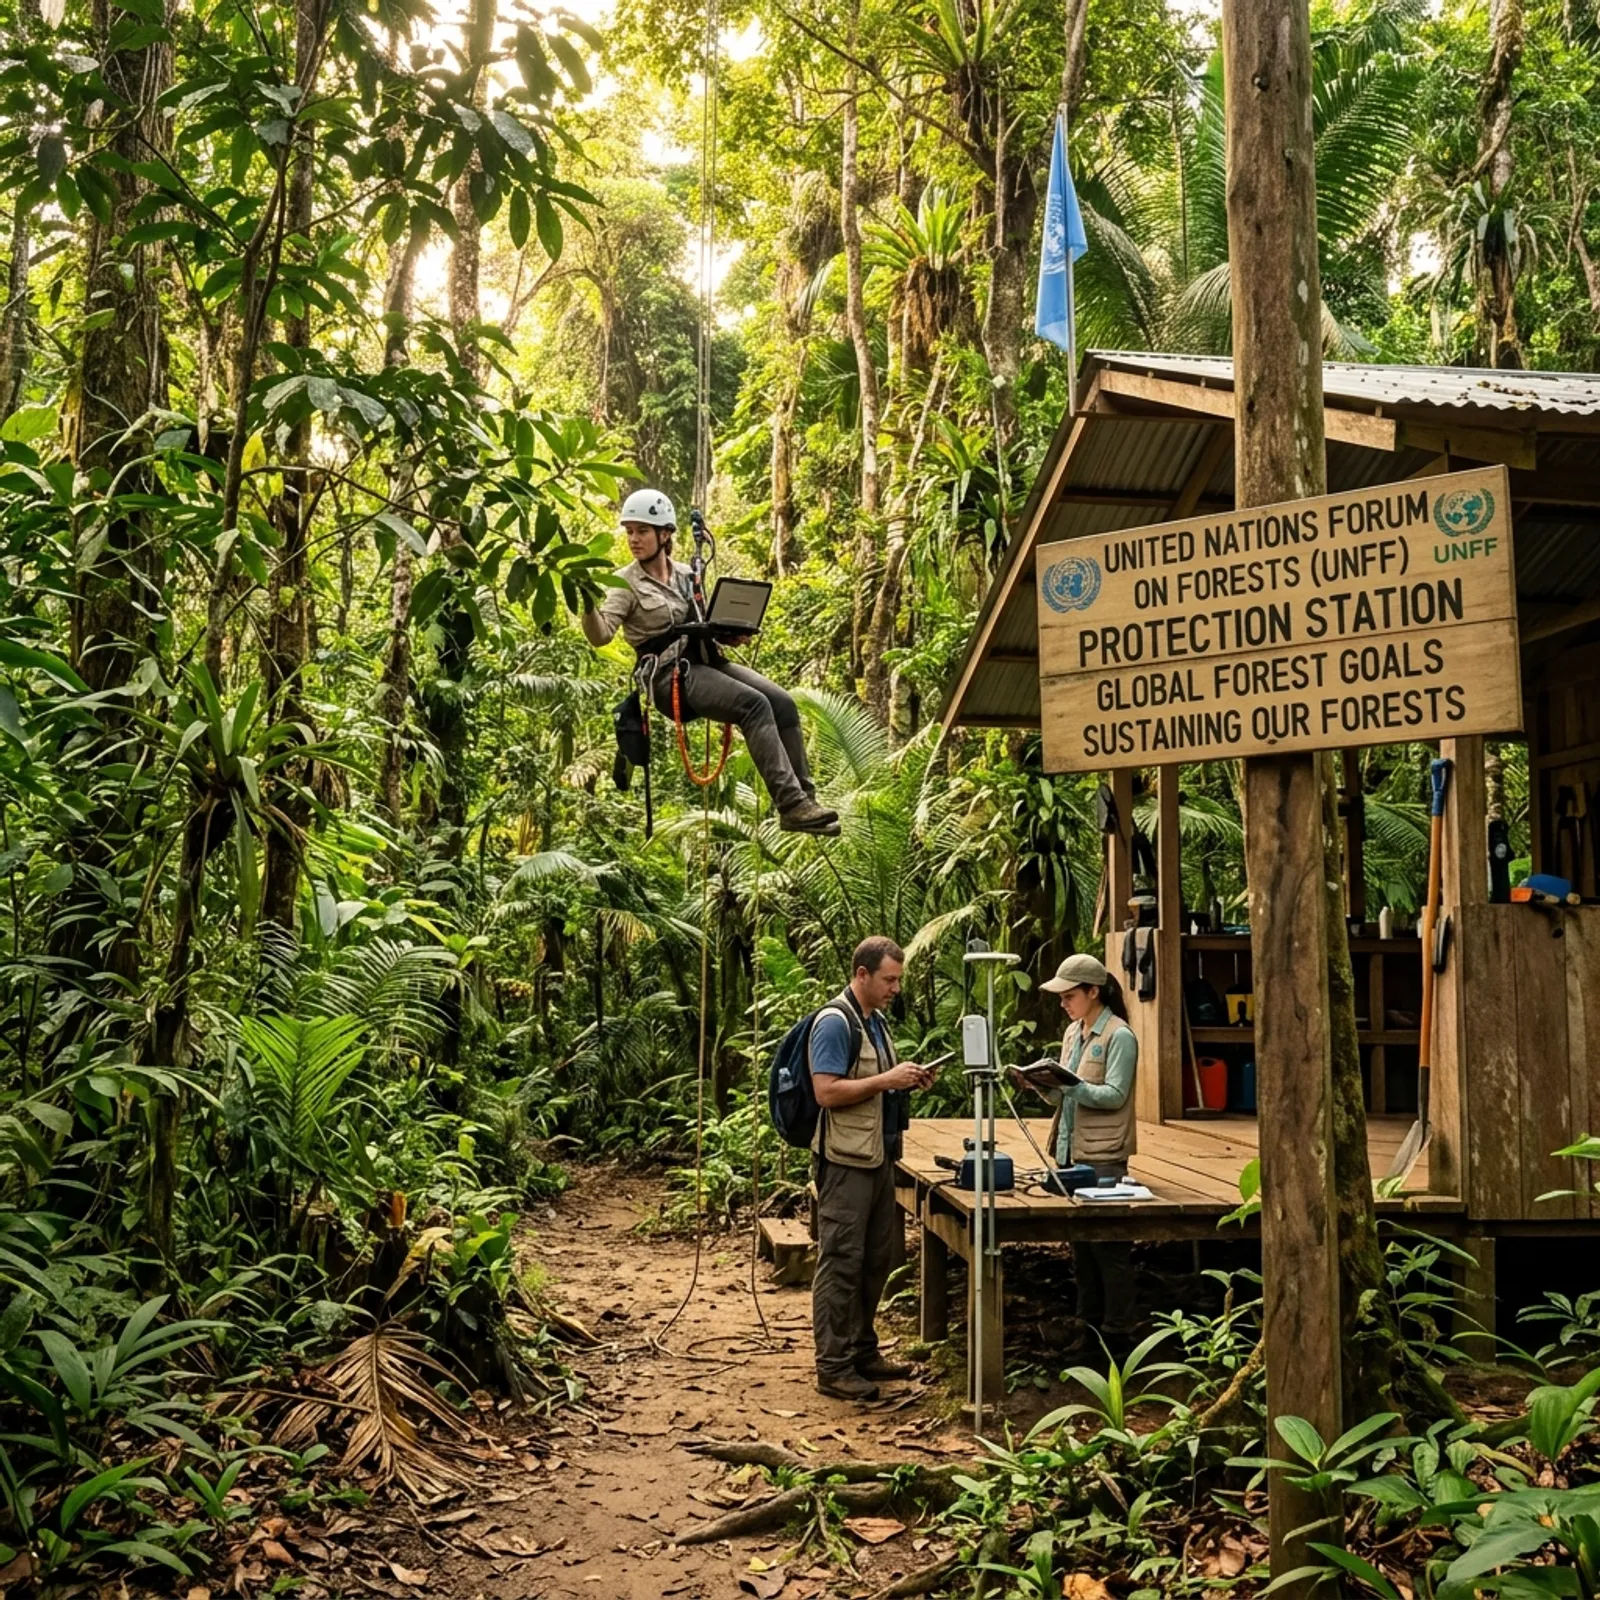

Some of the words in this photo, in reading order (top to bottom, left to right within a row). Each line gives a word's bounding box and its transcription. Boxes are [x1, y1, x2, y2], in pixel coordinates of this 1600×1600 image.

[1104, 531, 1195, 574] UNITED
[1205, 510, 1319, 558] NATIONS
[1328, 490, 1429, 539] FORUM
[1433, 537, 1498, 565] UNFF
[1134, 575, 1168, 610] ON
[1177, 555, 1300, 604] FORESTS
[1310, 535, 1410, 588] (UNFF)
[1079, 601, 1292, 669] PROTECTION
[1305, 577, 1464, 639] STATION
[1096, 668, 1205, 712] GLOBAL
[1213, 651, 1328, 699] FOREST
[1339, 638, 1444, 685] GOALS
[1082, 709, 1242, 758] SUSTAINING
[1251, 702, 1311, 741] OUR
[1320, 684, 1466, 735] FORESTS
